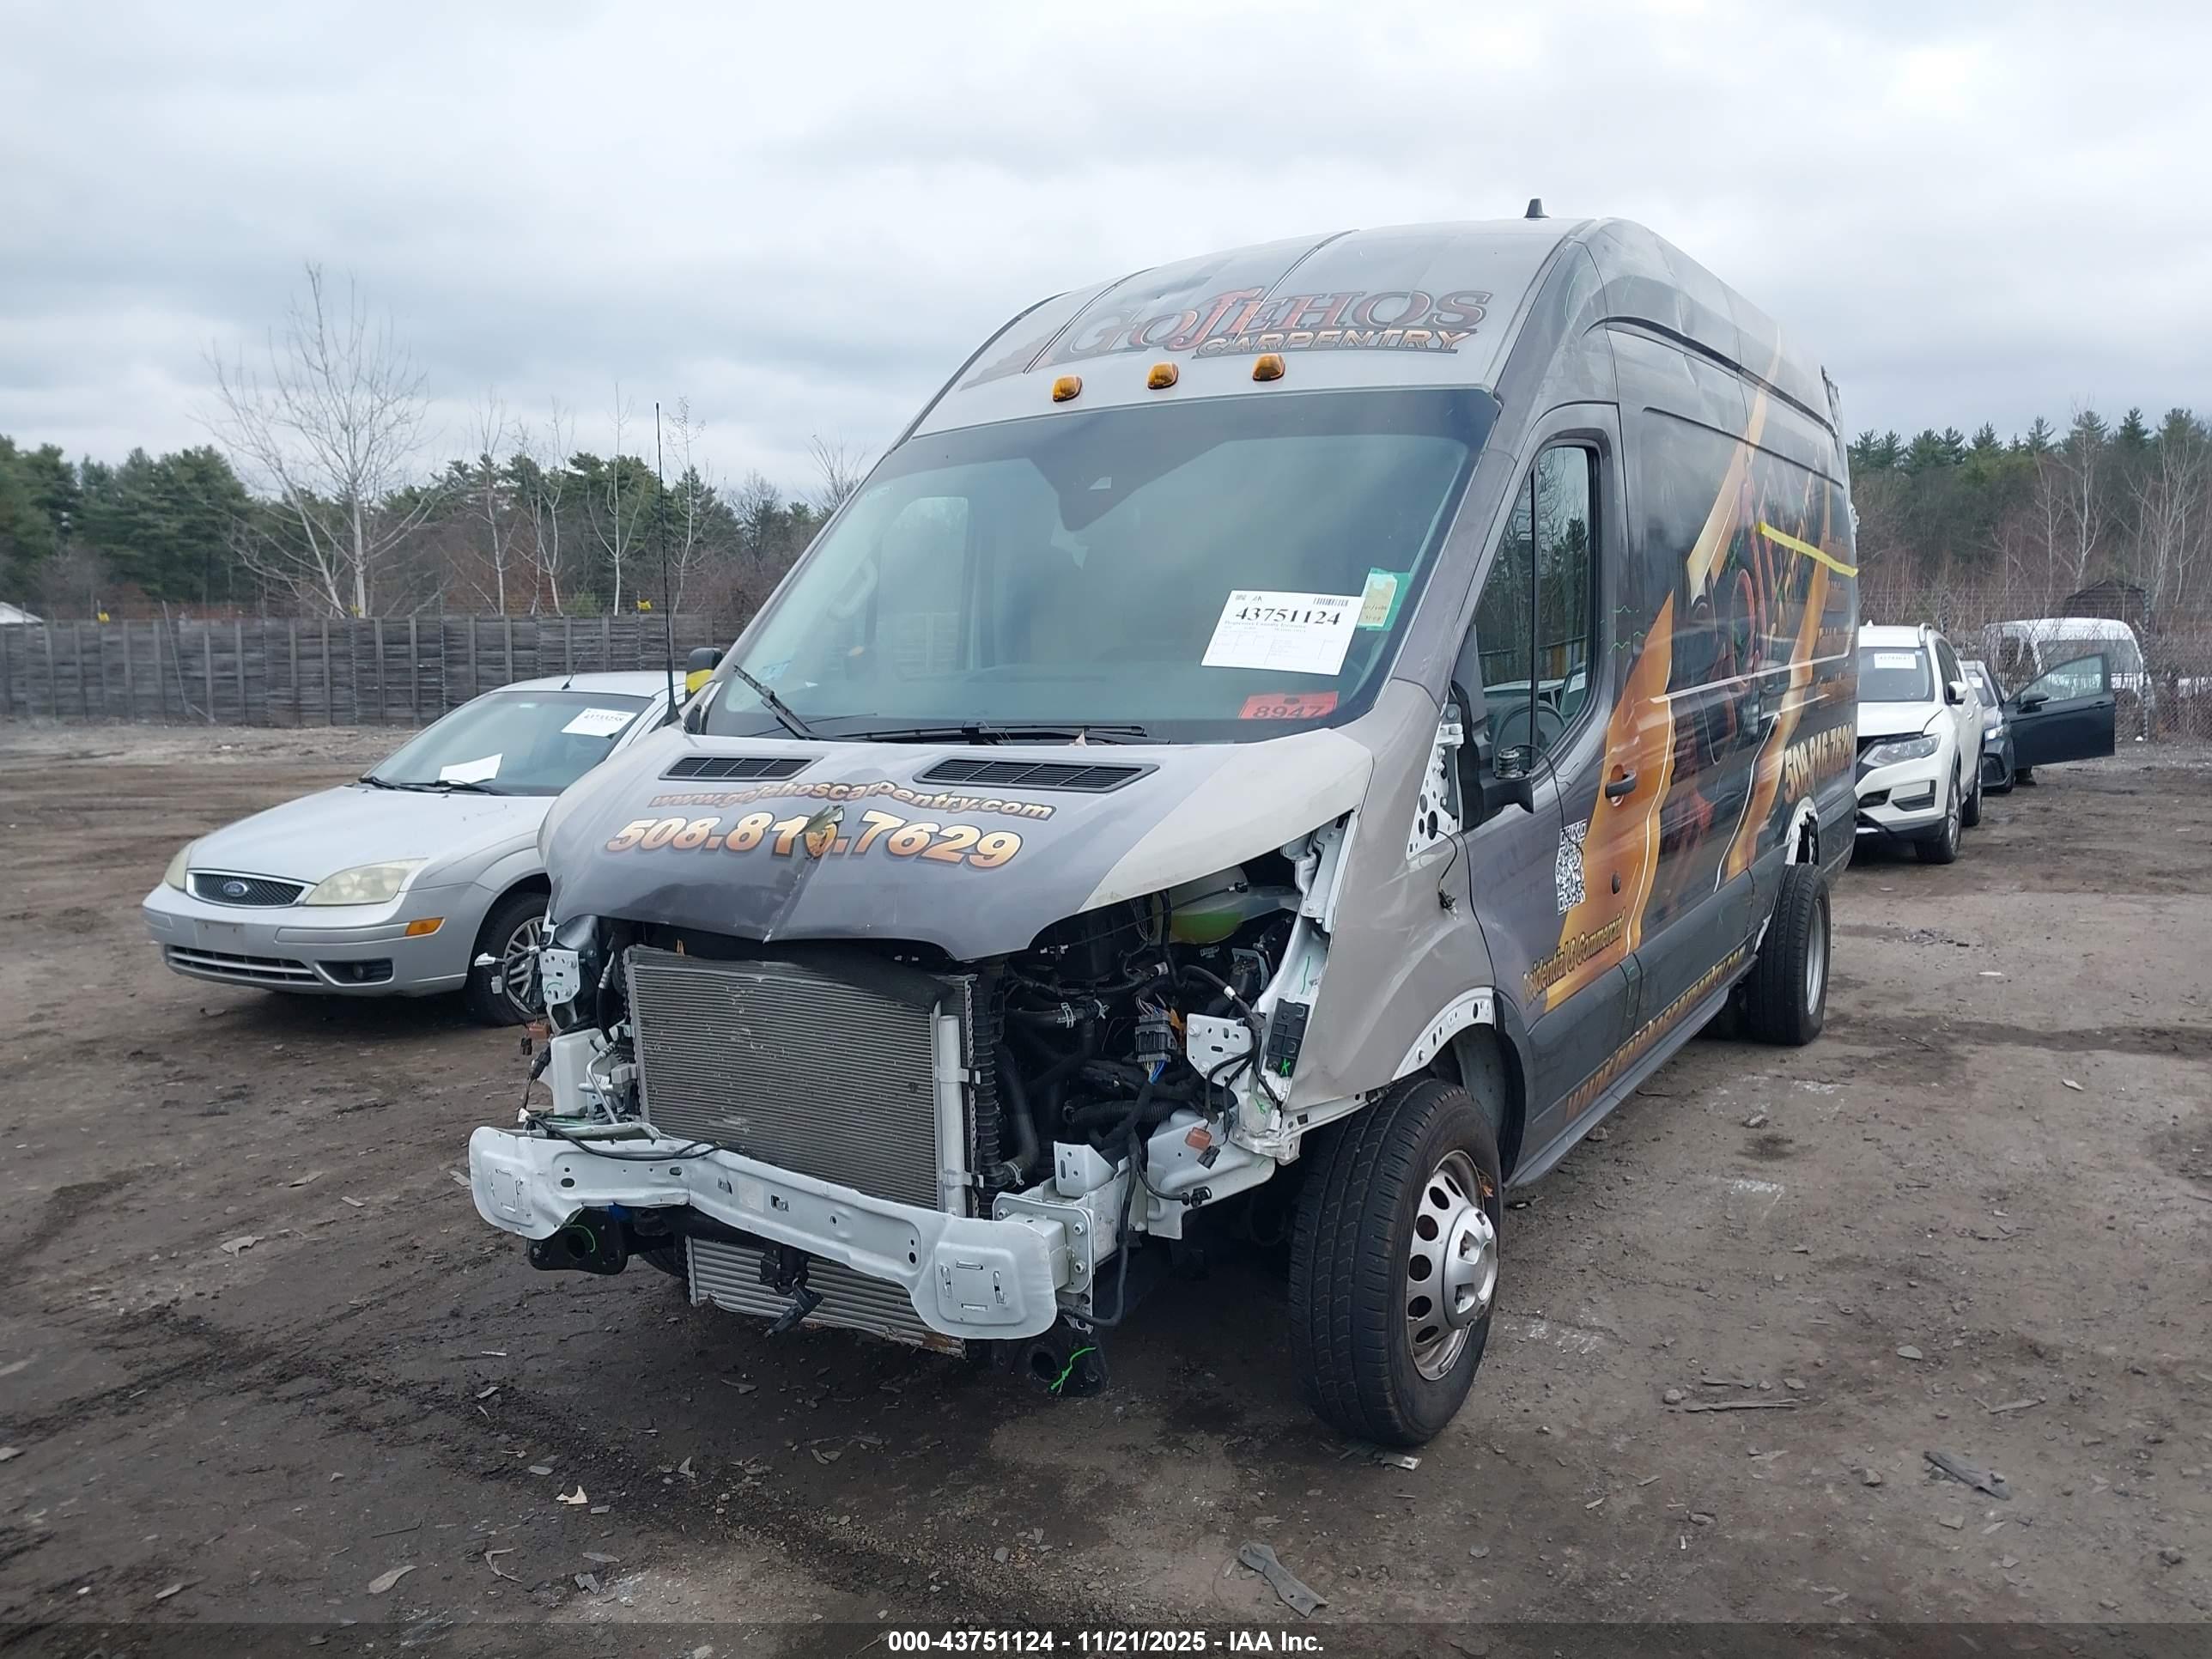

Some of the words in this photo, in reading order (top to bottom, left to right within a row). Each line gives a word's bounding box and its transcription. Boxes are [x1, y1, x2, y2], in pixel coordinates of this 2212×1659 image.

[1197, 329, 1473, 357] CARPENTRY
[1235, 606, 1341, 626] 43751124
[1253, 706, 1325, 719] 8947
